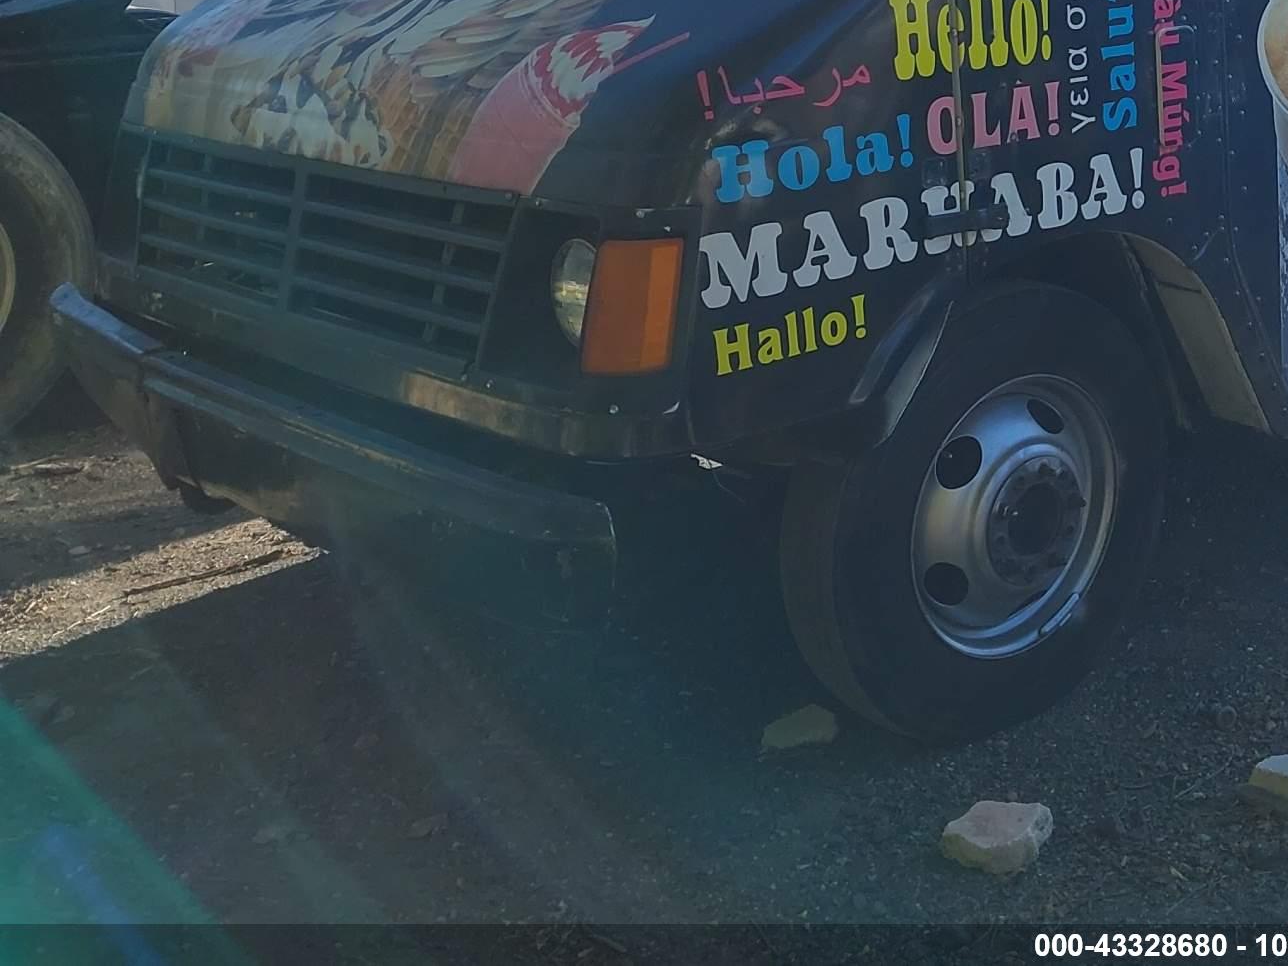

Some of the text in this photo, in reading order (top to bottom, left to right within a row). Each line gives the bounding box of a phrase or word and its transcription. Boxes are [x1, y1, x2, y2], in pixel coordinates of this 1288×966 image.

[711, 112, 915, 205] Hola!
[697, 146, 1148, 311] MARHABA!
[712, 294, 869, 377] Hallo!
